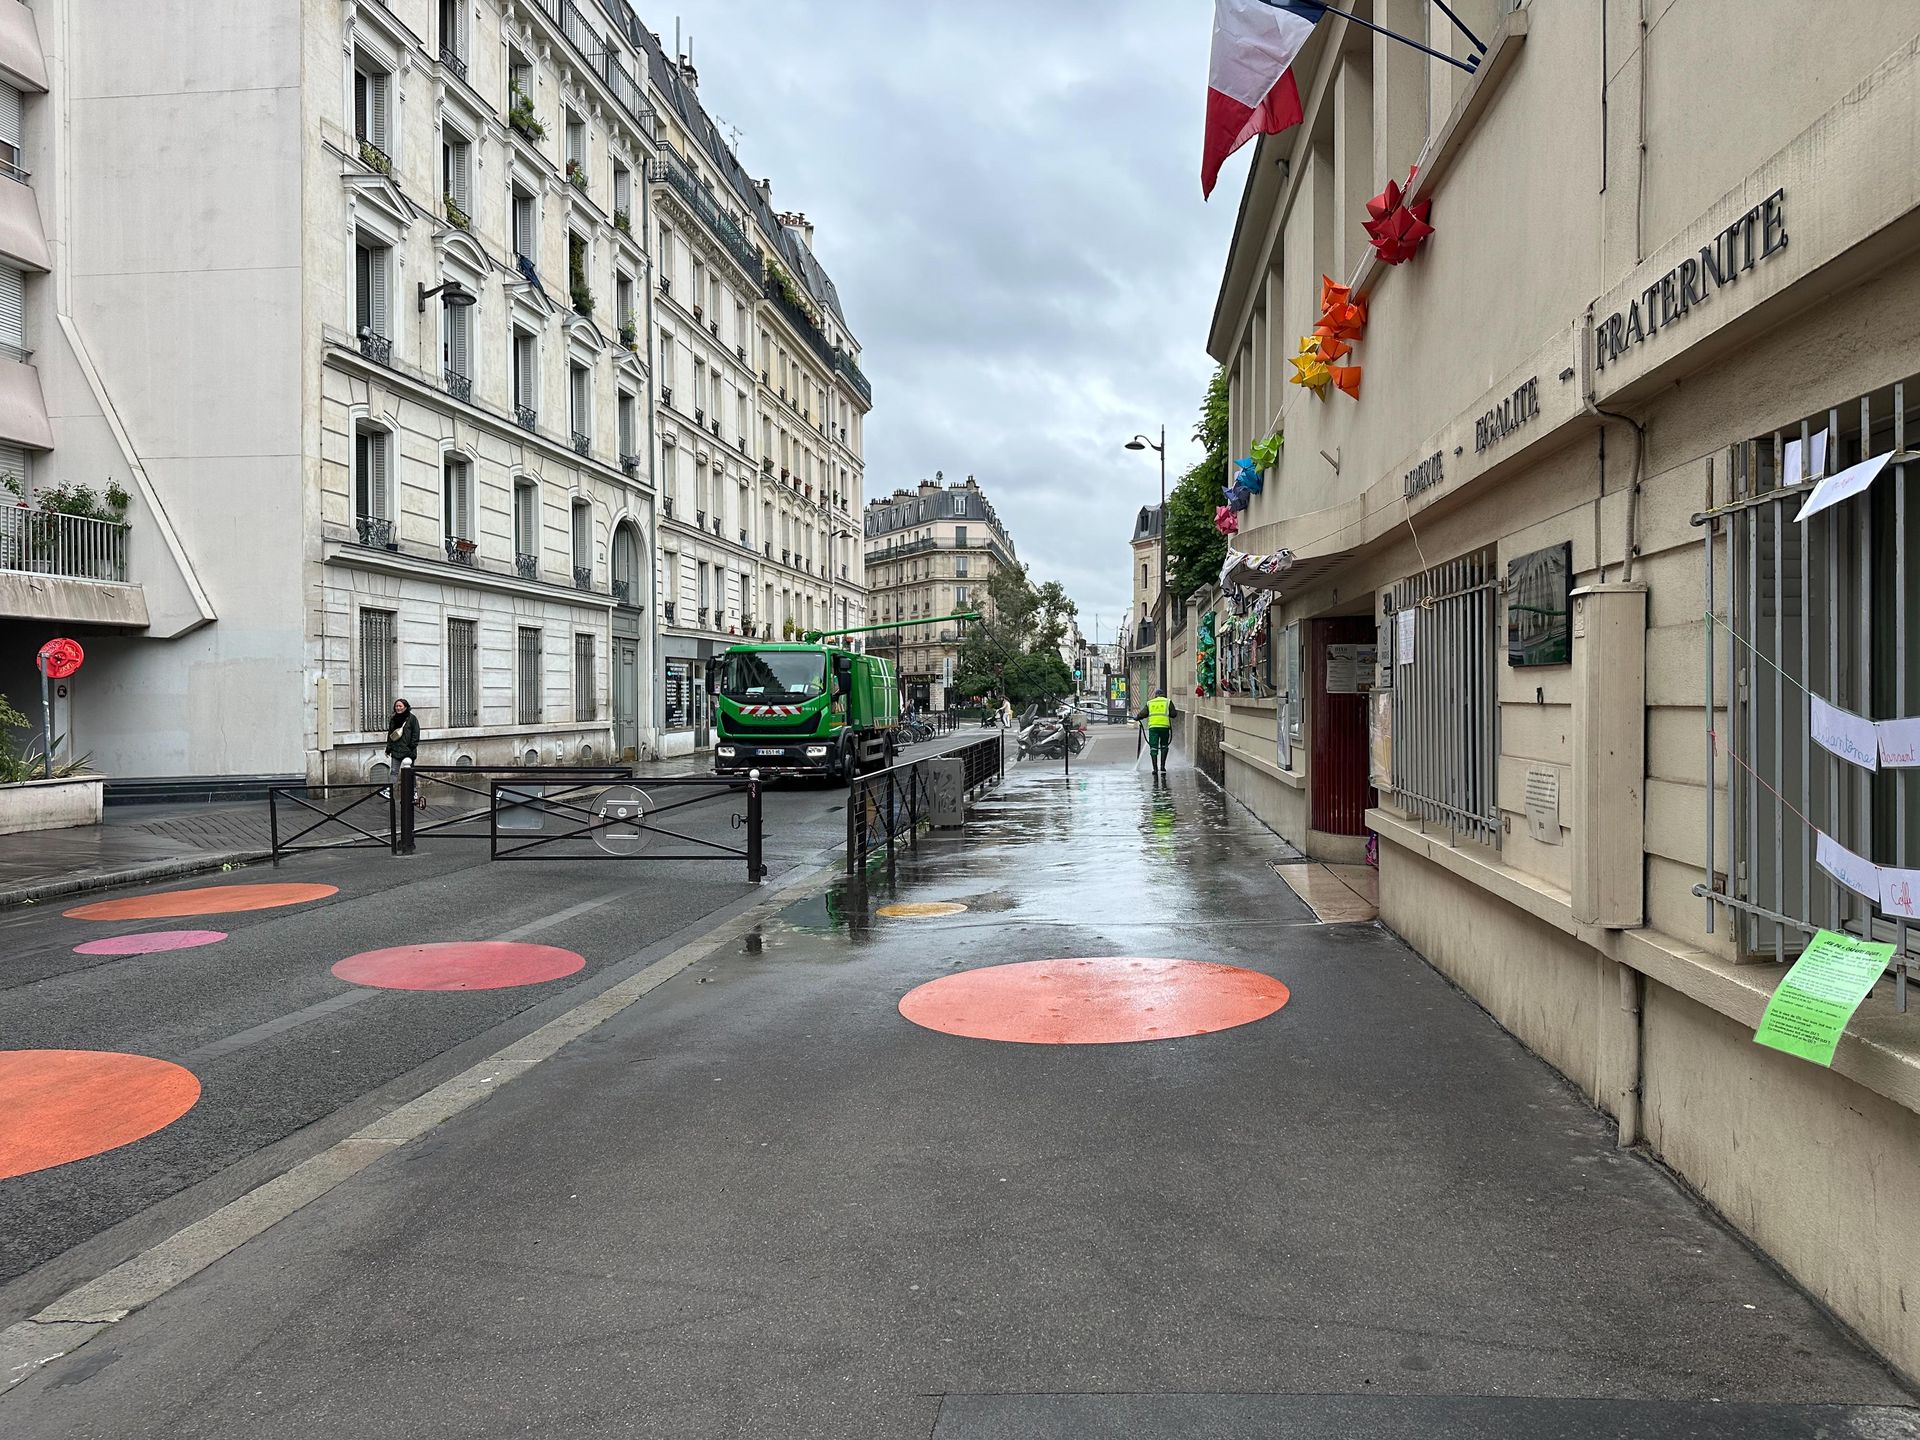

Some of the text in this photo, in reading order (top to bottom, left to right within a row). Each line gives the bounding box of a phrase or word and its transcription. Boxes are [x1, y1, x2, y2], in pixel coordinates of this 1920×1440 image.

[1404, 450, 1443, 499] LIBERTE
[1474, 375, 1540, 453] EGALITE
[1595, 187, 1788, 370] FRATERNITE
